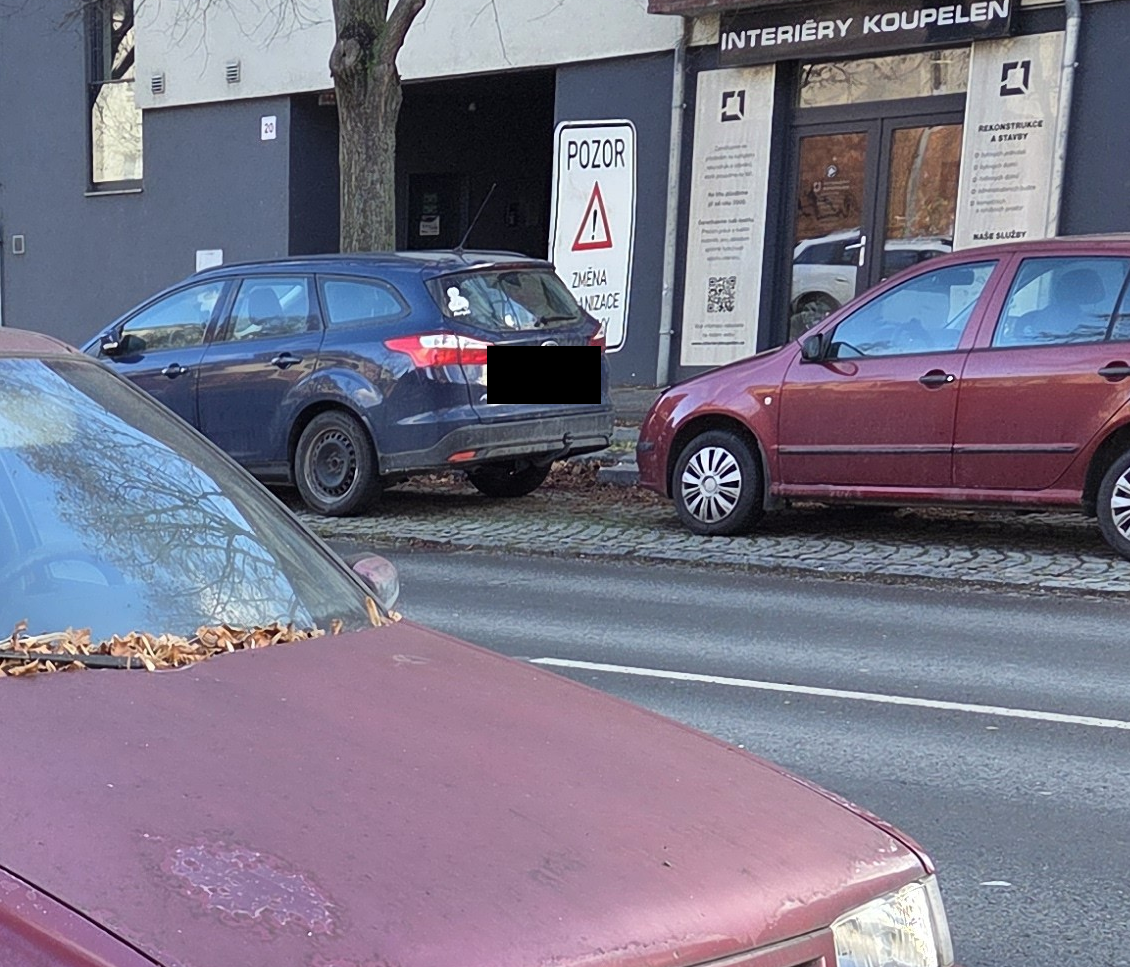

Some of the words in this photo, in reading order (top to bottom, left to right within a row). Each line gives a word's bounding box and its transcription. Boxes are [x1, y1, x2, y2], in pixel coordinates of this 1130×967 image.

[721, 17, 854, 51] INTERIÉRY
[863, 0, 1010, 35] KOUPELEN
[264, 122, 275, 133] 20
[978, 120, 1044, 132] REKONSTRUKCE
[990, 134, 997, 142] A
[998, 133, 1028, 142] STAVBY
[567, 138, 626, 170] POZOR
[973, 231, 995, 240] NAŠE
[996, 230, 1027, 240] SLUŽBY
[572, 266, 607, 288] ZMĚNA
